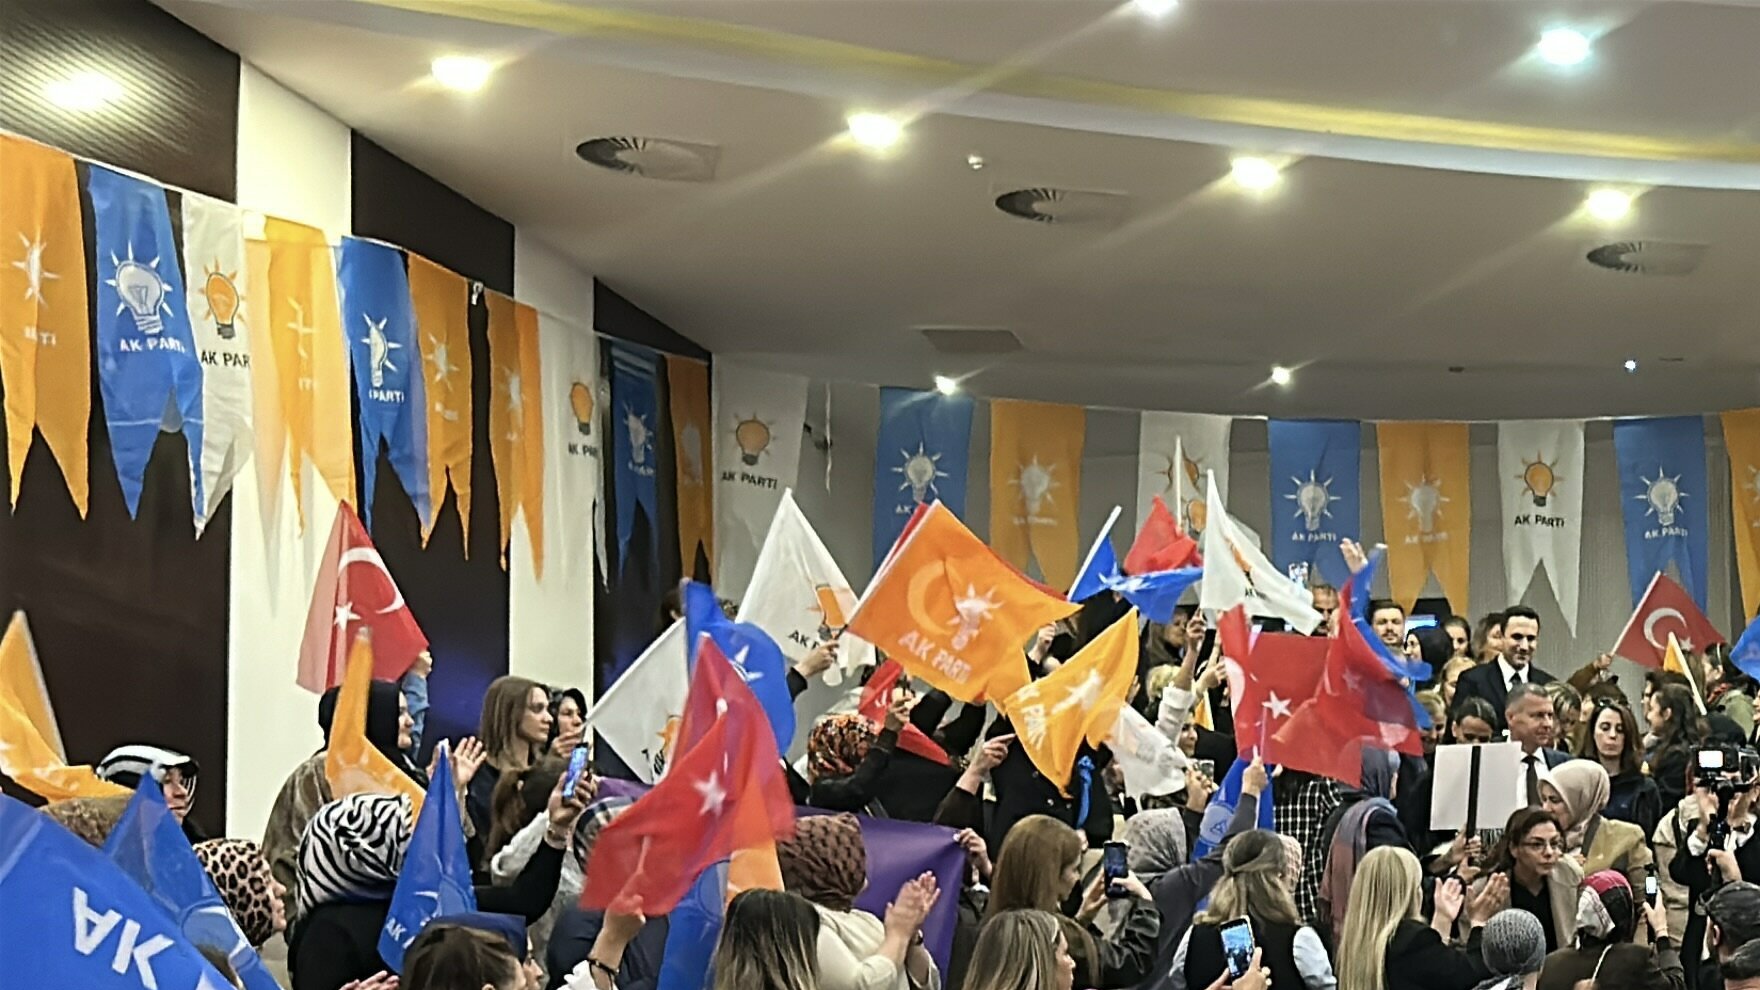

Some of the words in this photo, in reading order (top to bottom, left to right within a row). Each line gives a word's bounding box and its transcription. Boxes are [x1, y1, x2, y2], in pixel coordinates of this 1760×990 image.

[119, 338, 142, 352] AK
[201, 349, 219, 366] AK
[222, 352, 251, 369] PAR
[1513, 515, 1531, 526] AK
[788, 628, 810, 647] AK
[898, 629, 936, 661] AK
